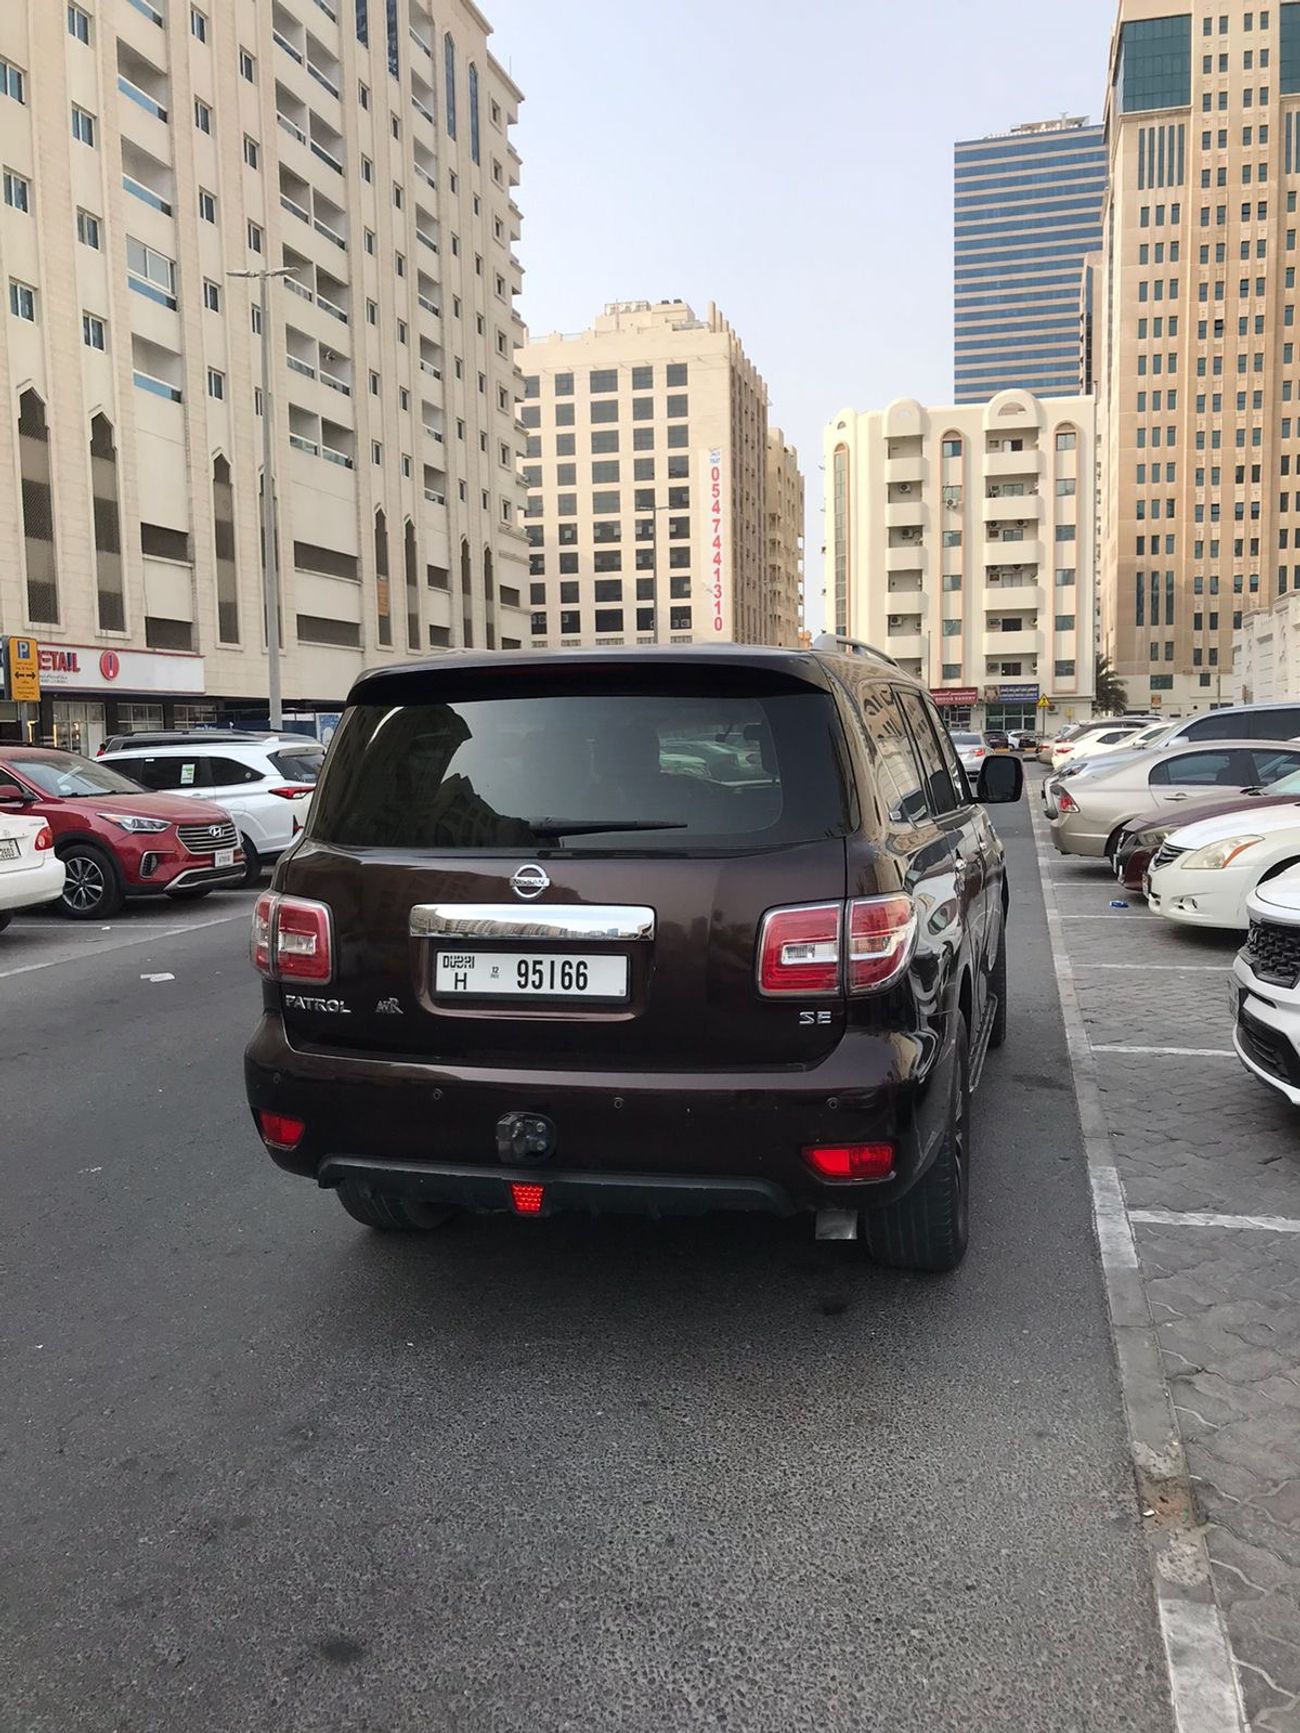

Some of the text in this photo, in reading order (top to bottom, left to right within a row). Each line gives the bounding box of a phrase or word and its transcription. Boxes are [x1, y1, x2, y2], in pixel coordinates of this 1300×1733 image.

[454, 972, 468, 990] H
[517, 959, 589, 991] 95166
[285, 994, 352, 1013] PATROL
[799, 1010, 832, 1025] SE
